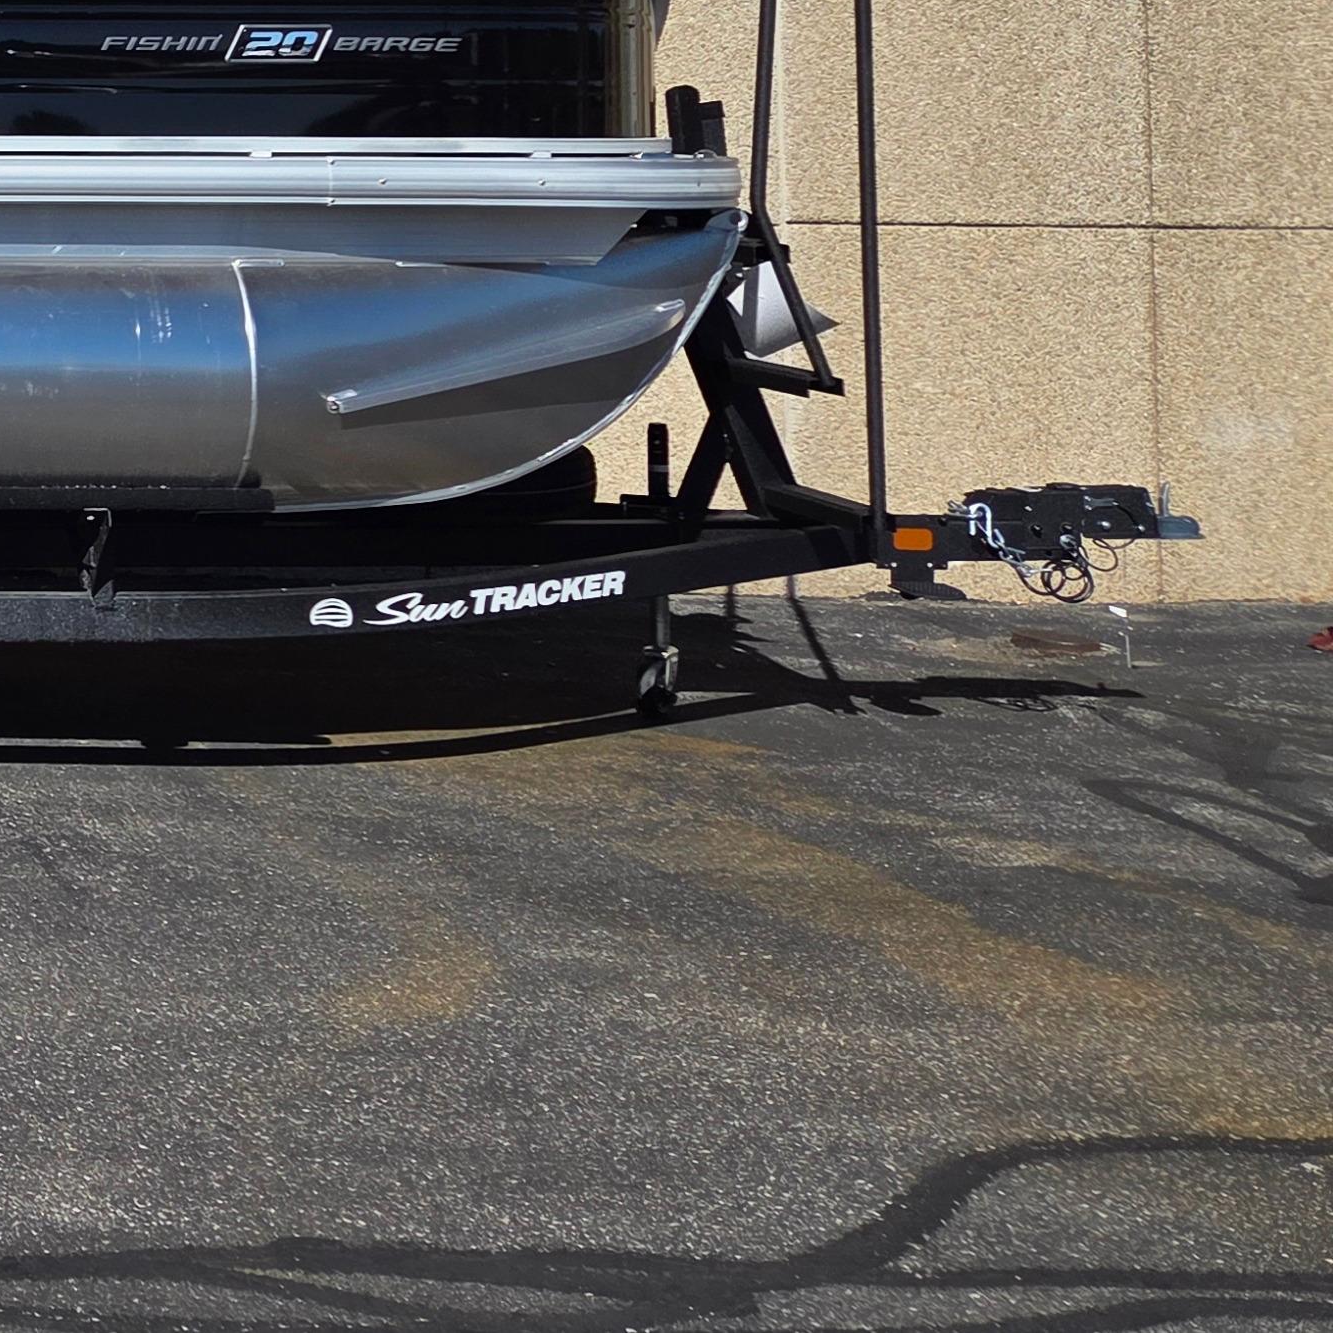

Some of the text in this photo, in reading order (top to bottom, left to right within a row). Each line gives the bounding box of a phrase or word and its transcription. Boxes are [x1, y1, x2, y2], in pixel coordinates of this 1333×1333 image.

[241, 31, 319, 57] 20
[333, 36, 462, 53] BARGE
[362, 570, 626, 626] Sun TRACKER
